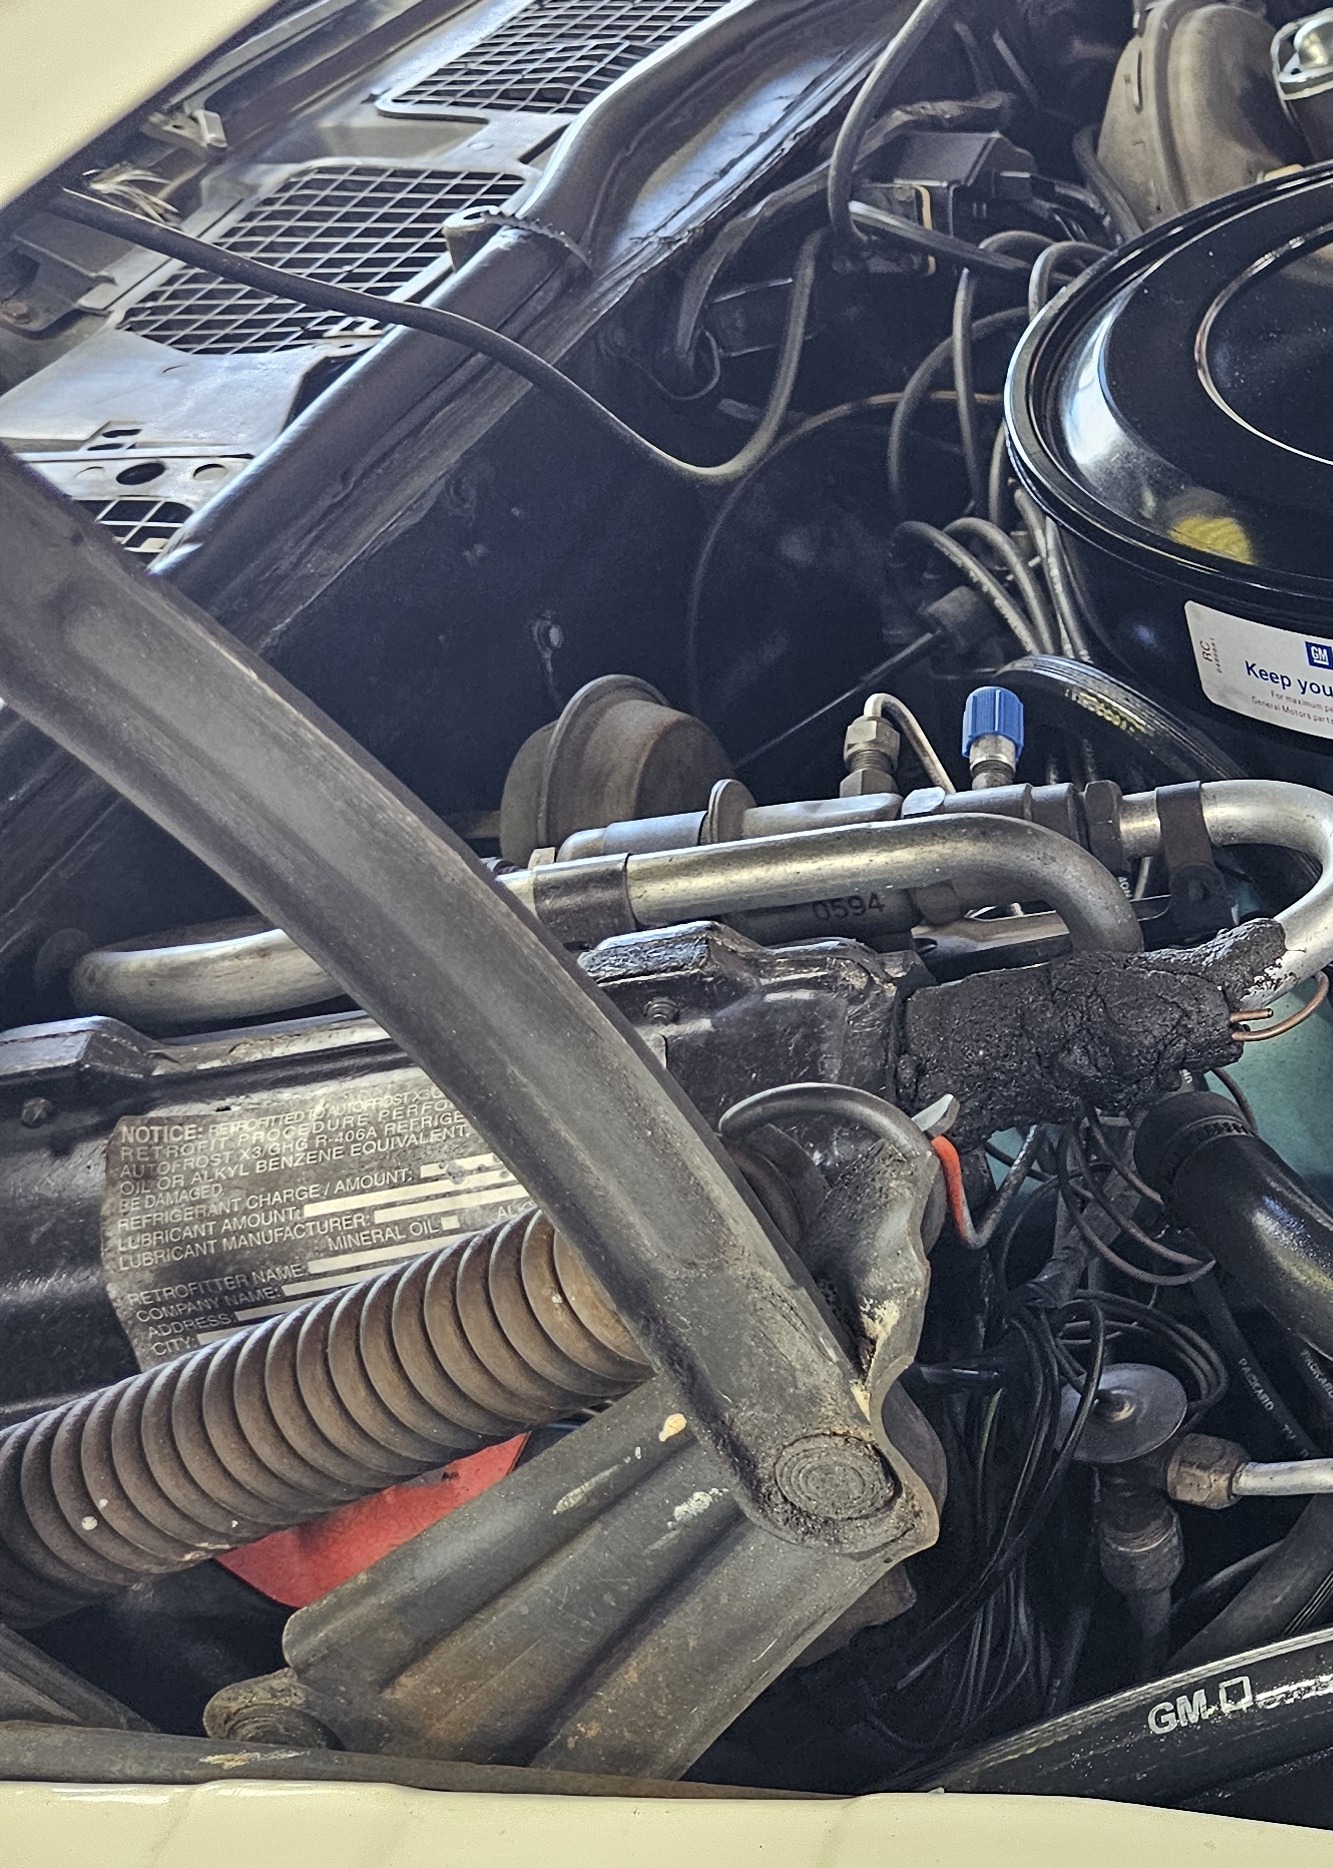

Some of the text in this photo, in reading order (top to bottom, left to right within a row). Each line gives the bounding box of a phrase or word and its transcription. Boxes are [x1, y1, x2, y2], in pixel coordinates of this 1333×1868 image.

[1310, 645, 1329, 664] GM
[1245, 660, 1292, 691] Keep
[1270, 689, 1285, 701] For
[1285, 695, 1325, 712] maximum
[1282, 704, 1312, 721] Motors
[811, 891, 886, 920] 0594
[121, 1124, 204, 1144] NOTICE:
[208, 1112, 305, 1137] RETROFITTED
[328, 1092, 410, 1118] AUTOFROST
[121, 1099, 456, 1162] RETROFIT PROCEDURE PERFO
[120, 1151, 232, 1178] AUTOFROST
[239, 1136, 310, 1160] X3/GHG
[314, 1128, 378, 1150] R-406A
[120, 1124, 471, 1197] OIL OR ALKYL BENZENE EQUIVALENT.
[117, 1198, 242, 1233] REFRIGERANT
[246, 1183, 320, 1210] CHARGE
[119, 1196, 141, 1214] BE
[117, 1206, 300, 1251] LUBRICANT AMOUNT:
[118, 1213, 371, 1271] LUBRICANT MANUFACTURER:
[327, 1218, 440, 1252] MINERAL OIL
[127, 1263, 308, 1307] RETROFITTER NAME:
[136, 1285, 283, 1323] COMPANY NAME:
[148, 1312, 237, 1340] ADDRESS:
[152, 1335, 199, 1357] CITY:
[1147, 1688, 1209, 1736] GM
